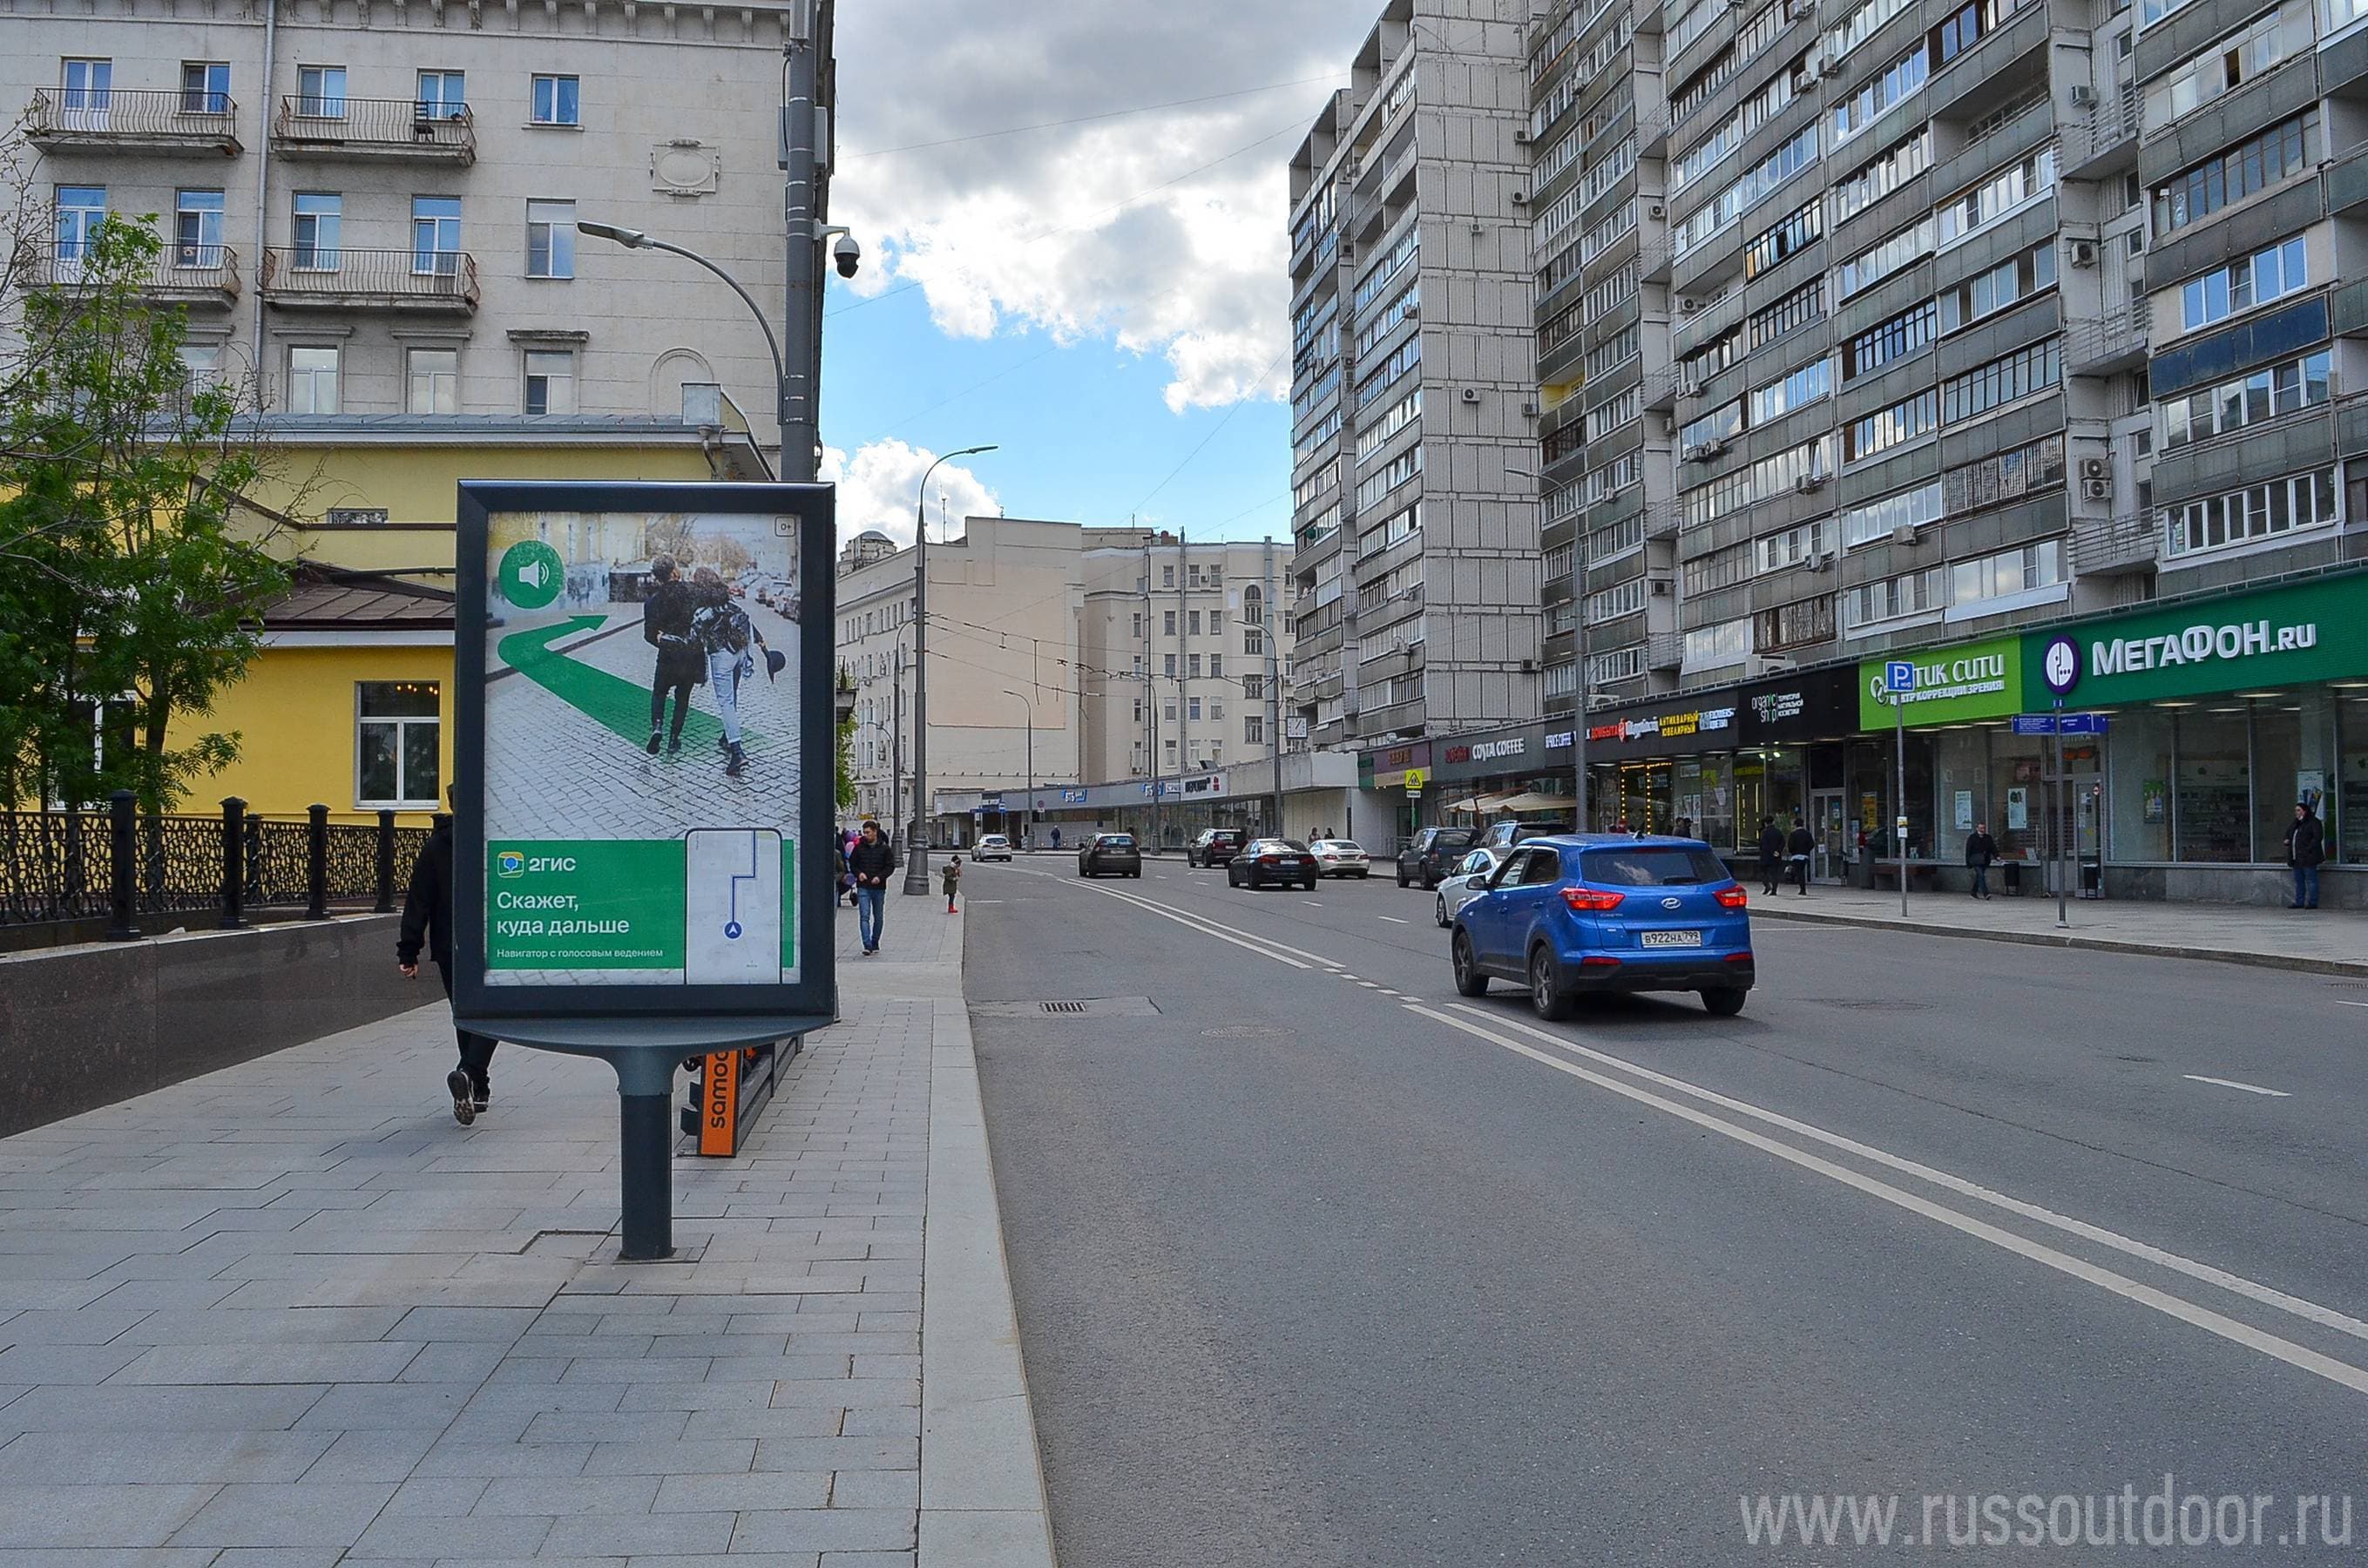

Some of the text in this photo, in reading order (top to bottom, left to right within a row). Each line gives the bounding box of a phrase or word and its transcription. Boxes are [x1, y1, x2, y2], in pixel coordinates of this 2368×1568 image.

[1894, 666, 1909, 687] P
[1967, 680, 2005, 694] ЗРЕНИЯ
[1472, 738, 1526, 761] COSTA COFFEE
[529, 857, 577, 871] 2ГИС
[497, 891, 579, 911] Скажет,
[497, 920, 630, 936] куда дальше
[497, 949, 548, 958] Навигатор
[558, 950, 612, 958] голосовым
[614, 950, 663, 958] ведением
